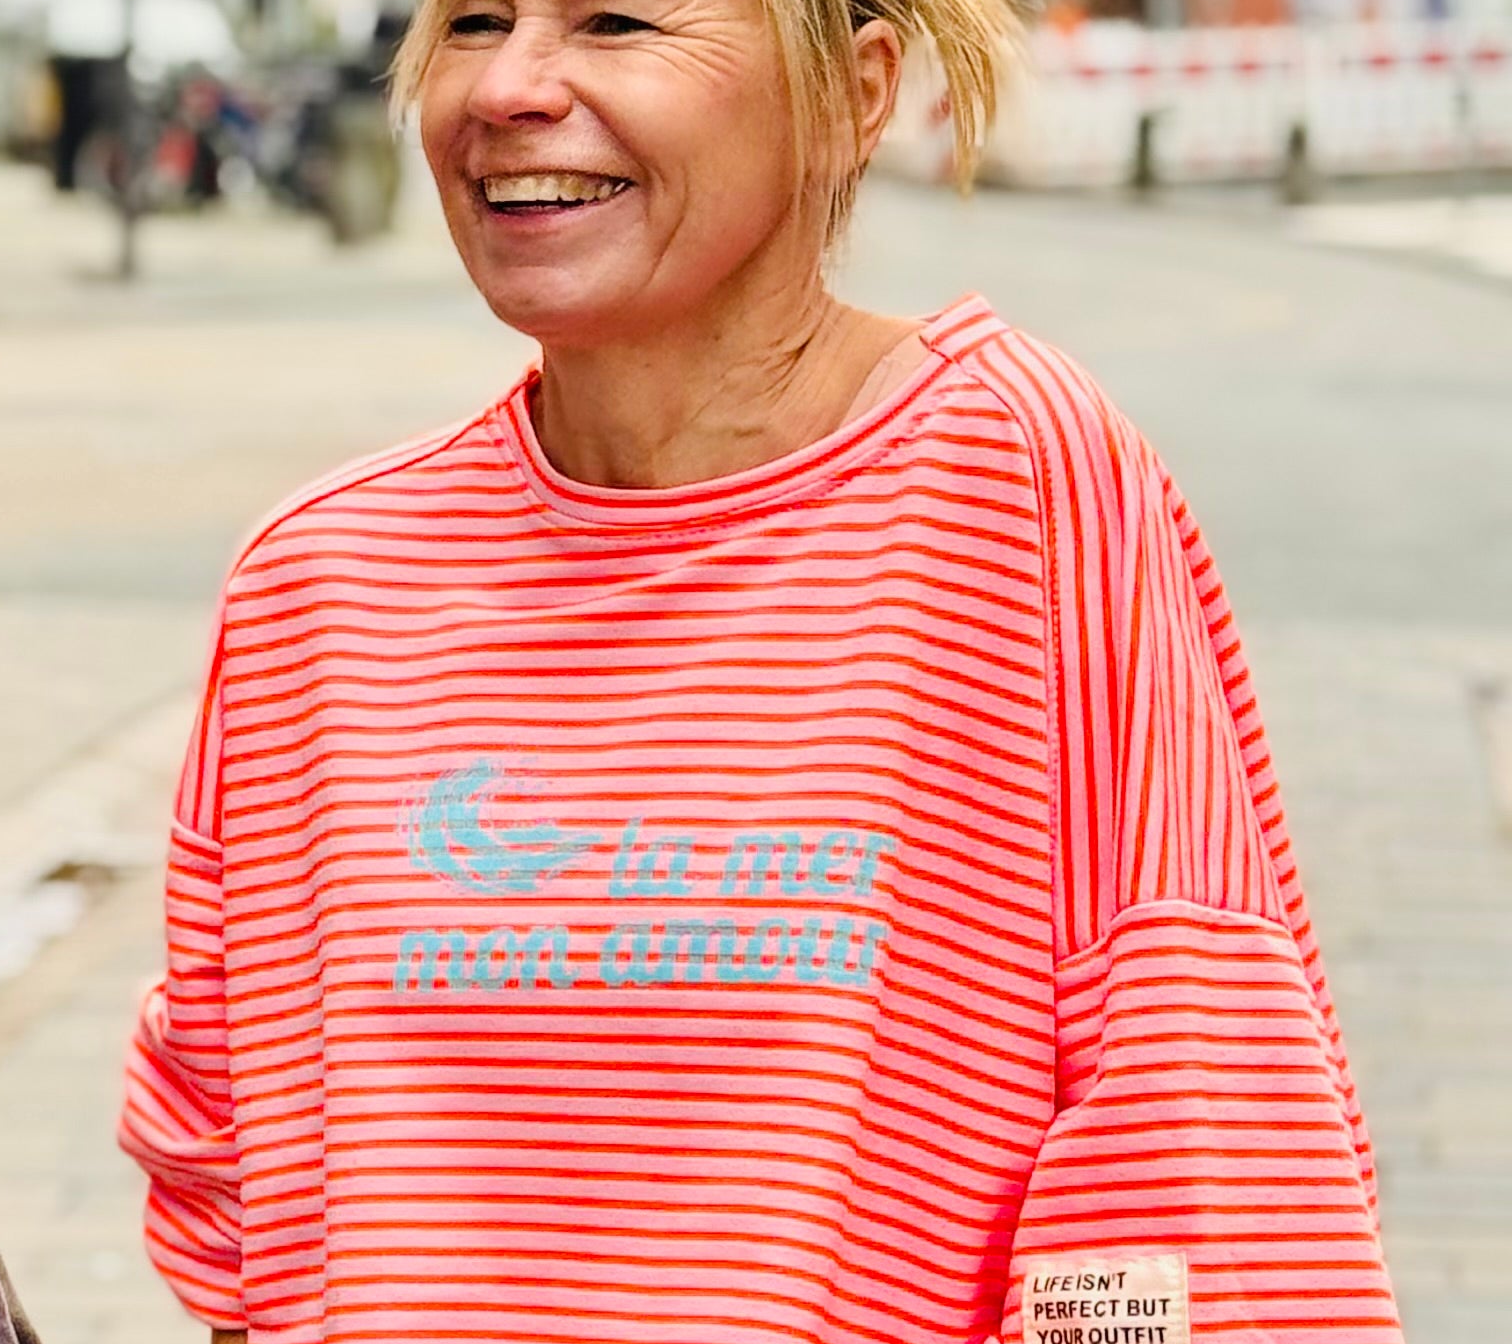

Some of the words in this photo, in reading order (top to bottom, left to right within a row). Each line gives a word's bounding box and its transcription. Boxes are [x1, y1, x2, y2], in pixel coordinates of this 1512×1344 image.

[607, 816, 696, 898] la
[718, 830, 896, 897] mer
[393, 926, 581, 993] mon
[600, 918, 886, 986] amour
[1033, 1276, 1073, 1292] LIFE
[1076, 1272, 1126, 1290] ISN'T
[1034, 1300, 1119, 1320] PERFECT
[1127, 1299, 1170, 1316] BUT
[1088, 1327, 1166, 1344] OUTFIT
